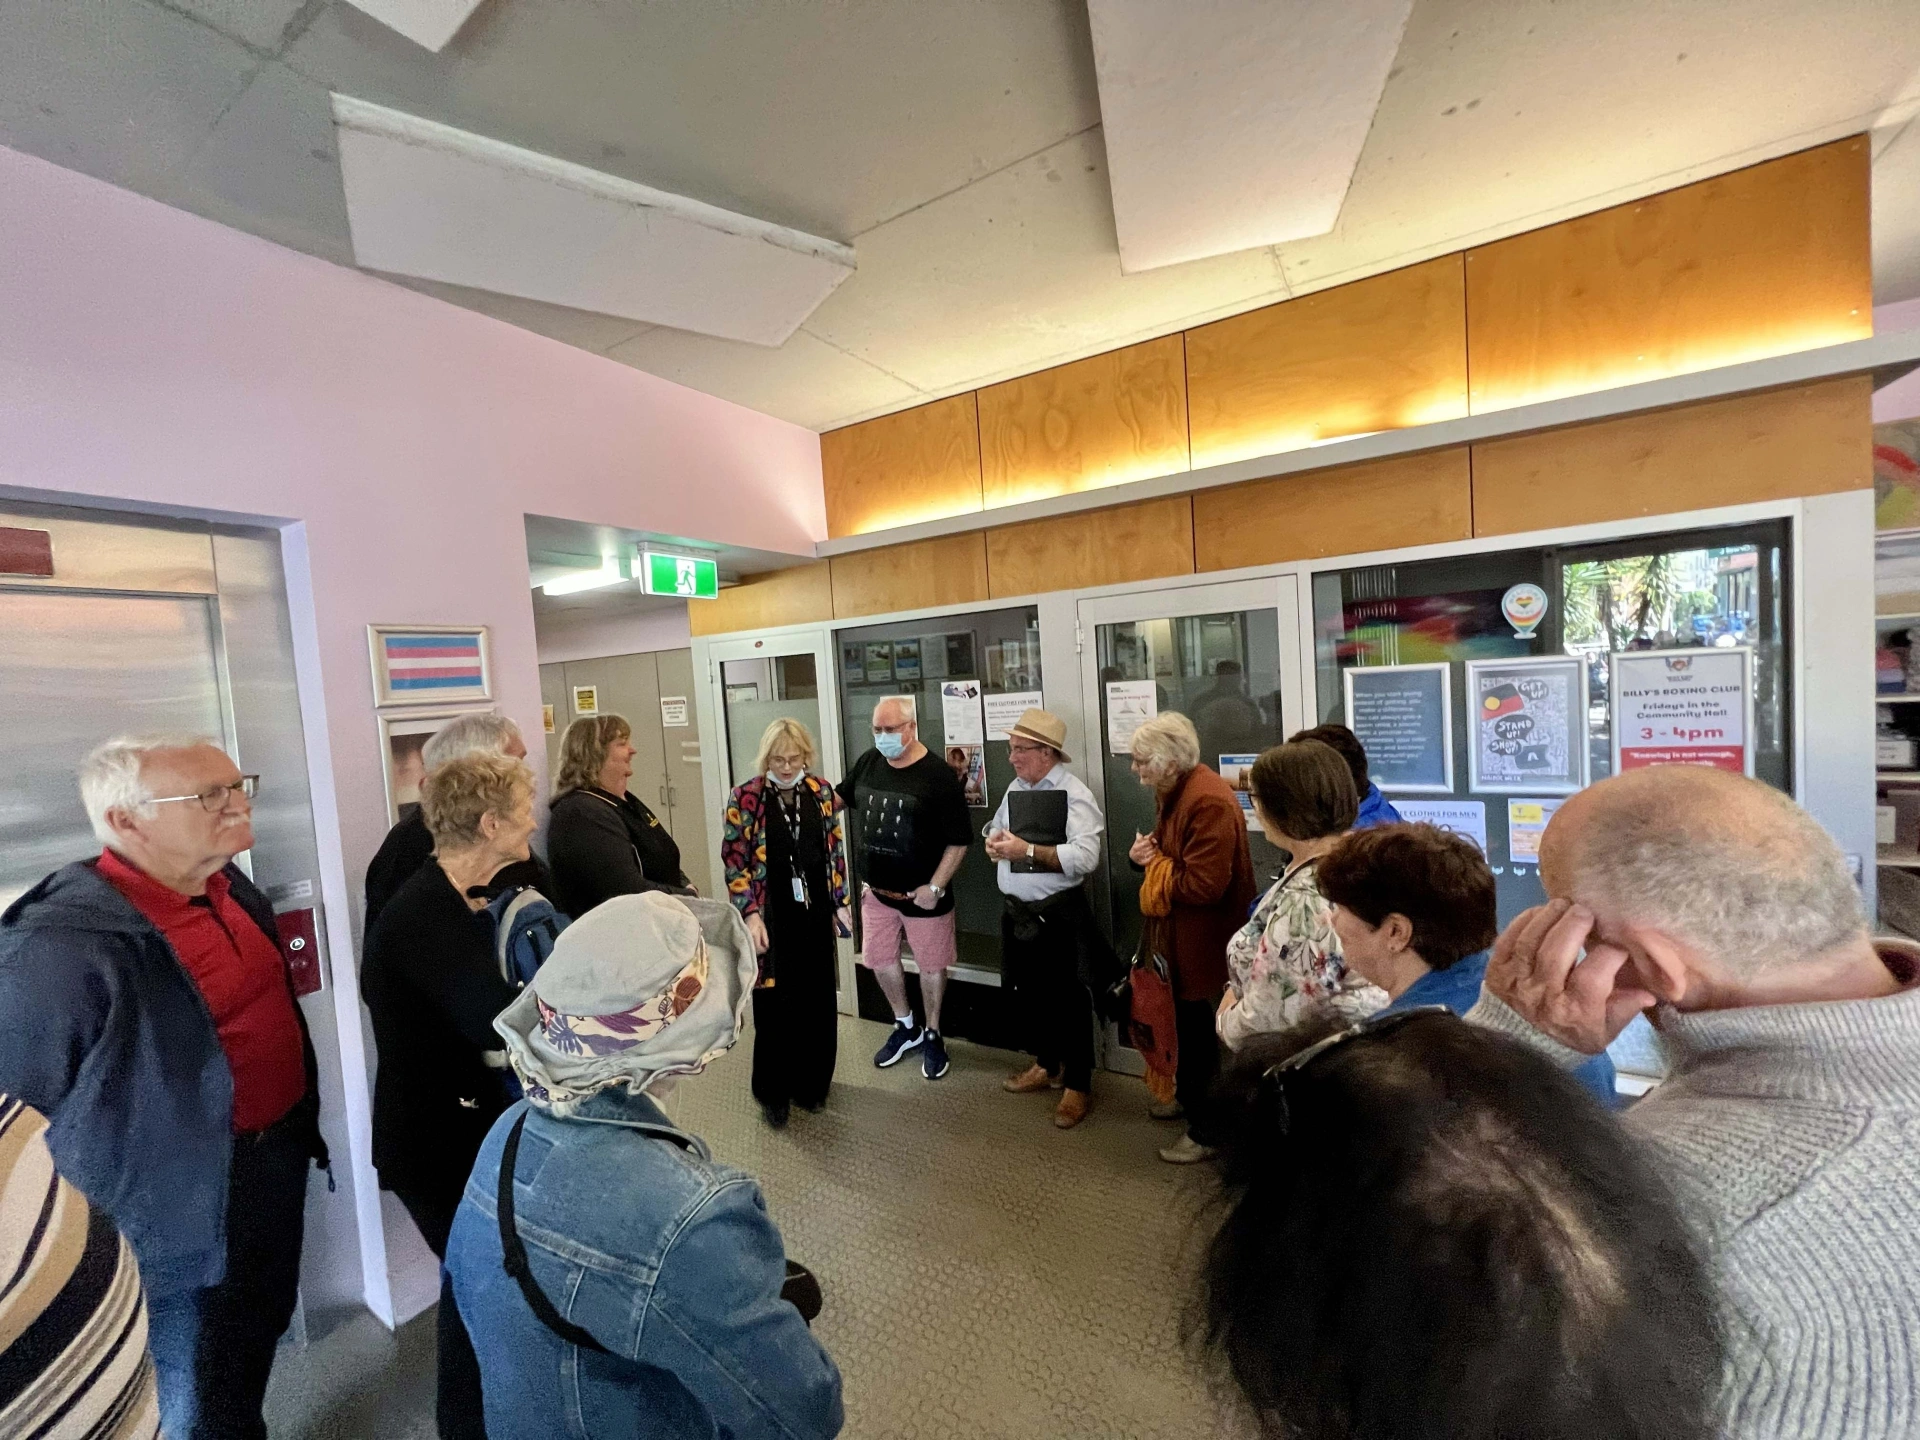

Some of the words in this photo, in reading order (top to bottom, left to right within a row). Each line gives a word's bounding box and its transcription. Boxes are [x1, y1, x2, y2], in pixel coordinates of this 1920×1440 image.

[1662, 687, 1707, 696] BOXING
[1710, 685, 1740, 693] CLUB
[1643, 702, 1684, 711] Fridays
[1687, 701, 1698, 709] in
[1637, 711, 1701, 719] Community
[1497, 720, 1532, 732] STAND
[1640, 727, 1653, 740] 3
[1673, 726, 1723, 742] 4pm
